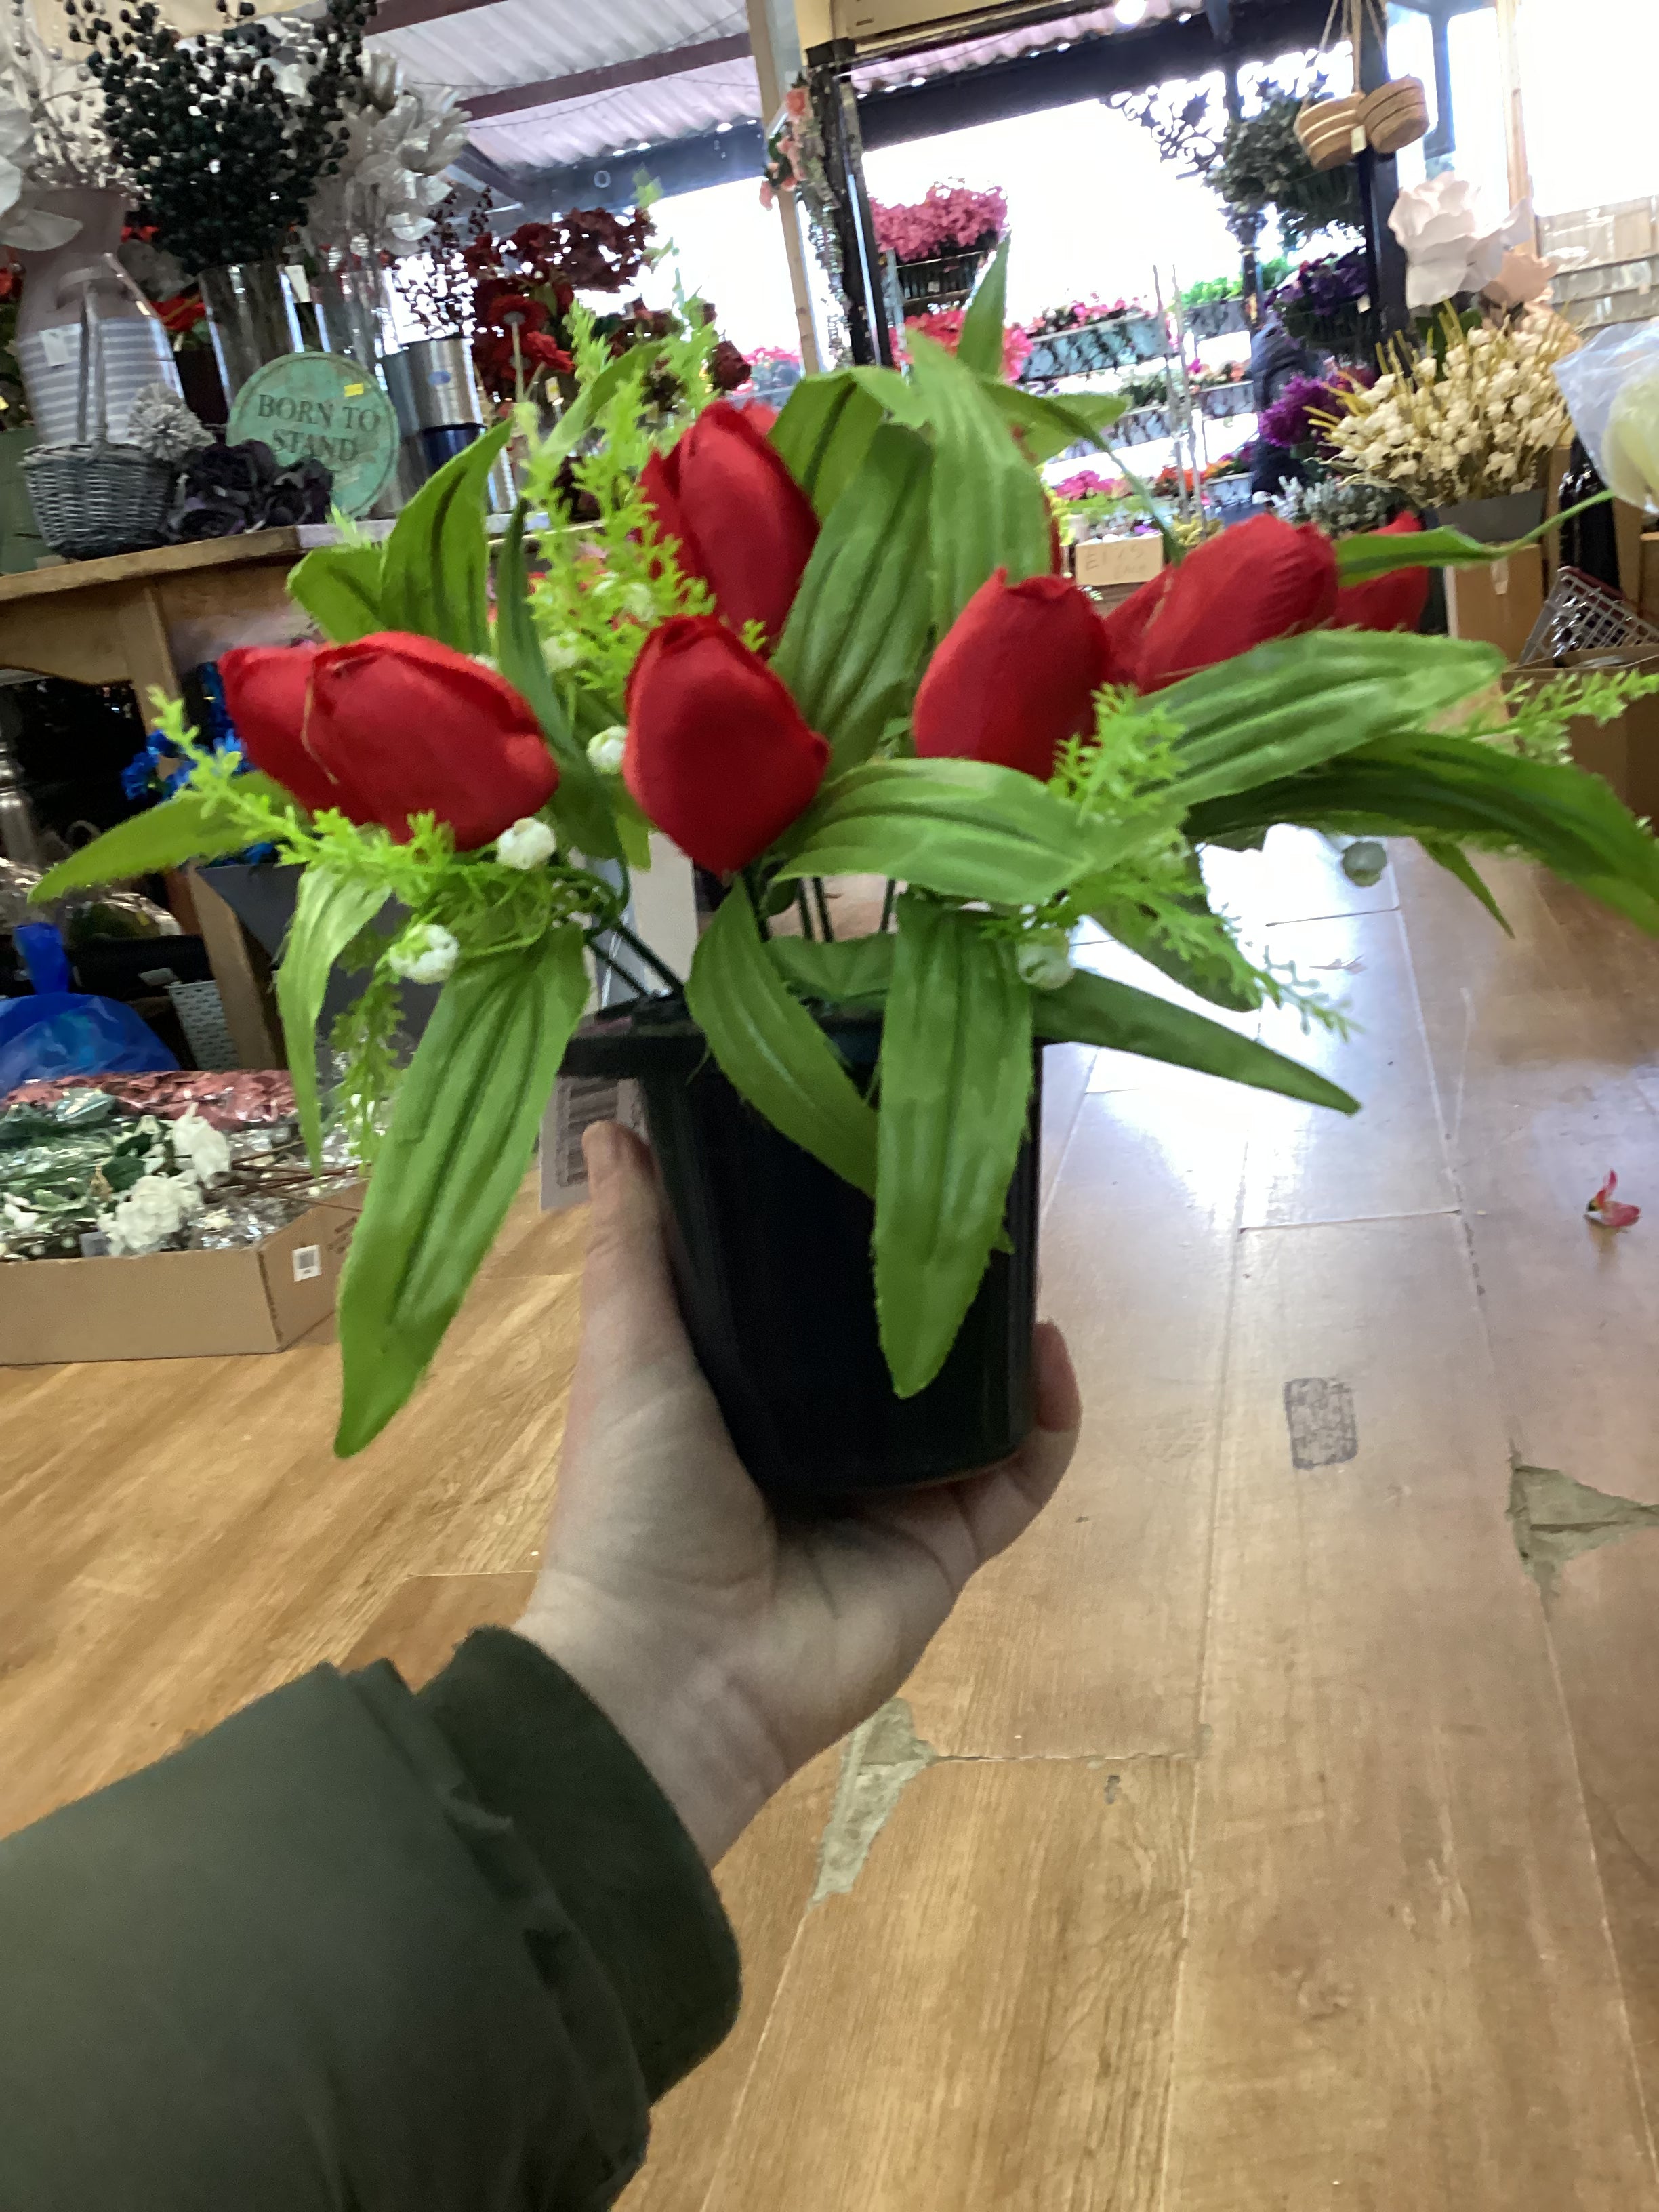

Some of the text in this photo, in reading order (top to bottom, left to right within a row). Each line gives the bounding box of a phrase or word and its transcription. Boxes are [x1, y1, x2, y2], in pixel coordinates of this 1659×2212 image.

[258, 394, 380, 432] BORN TO
[272, 429, 359, 462] STAND
